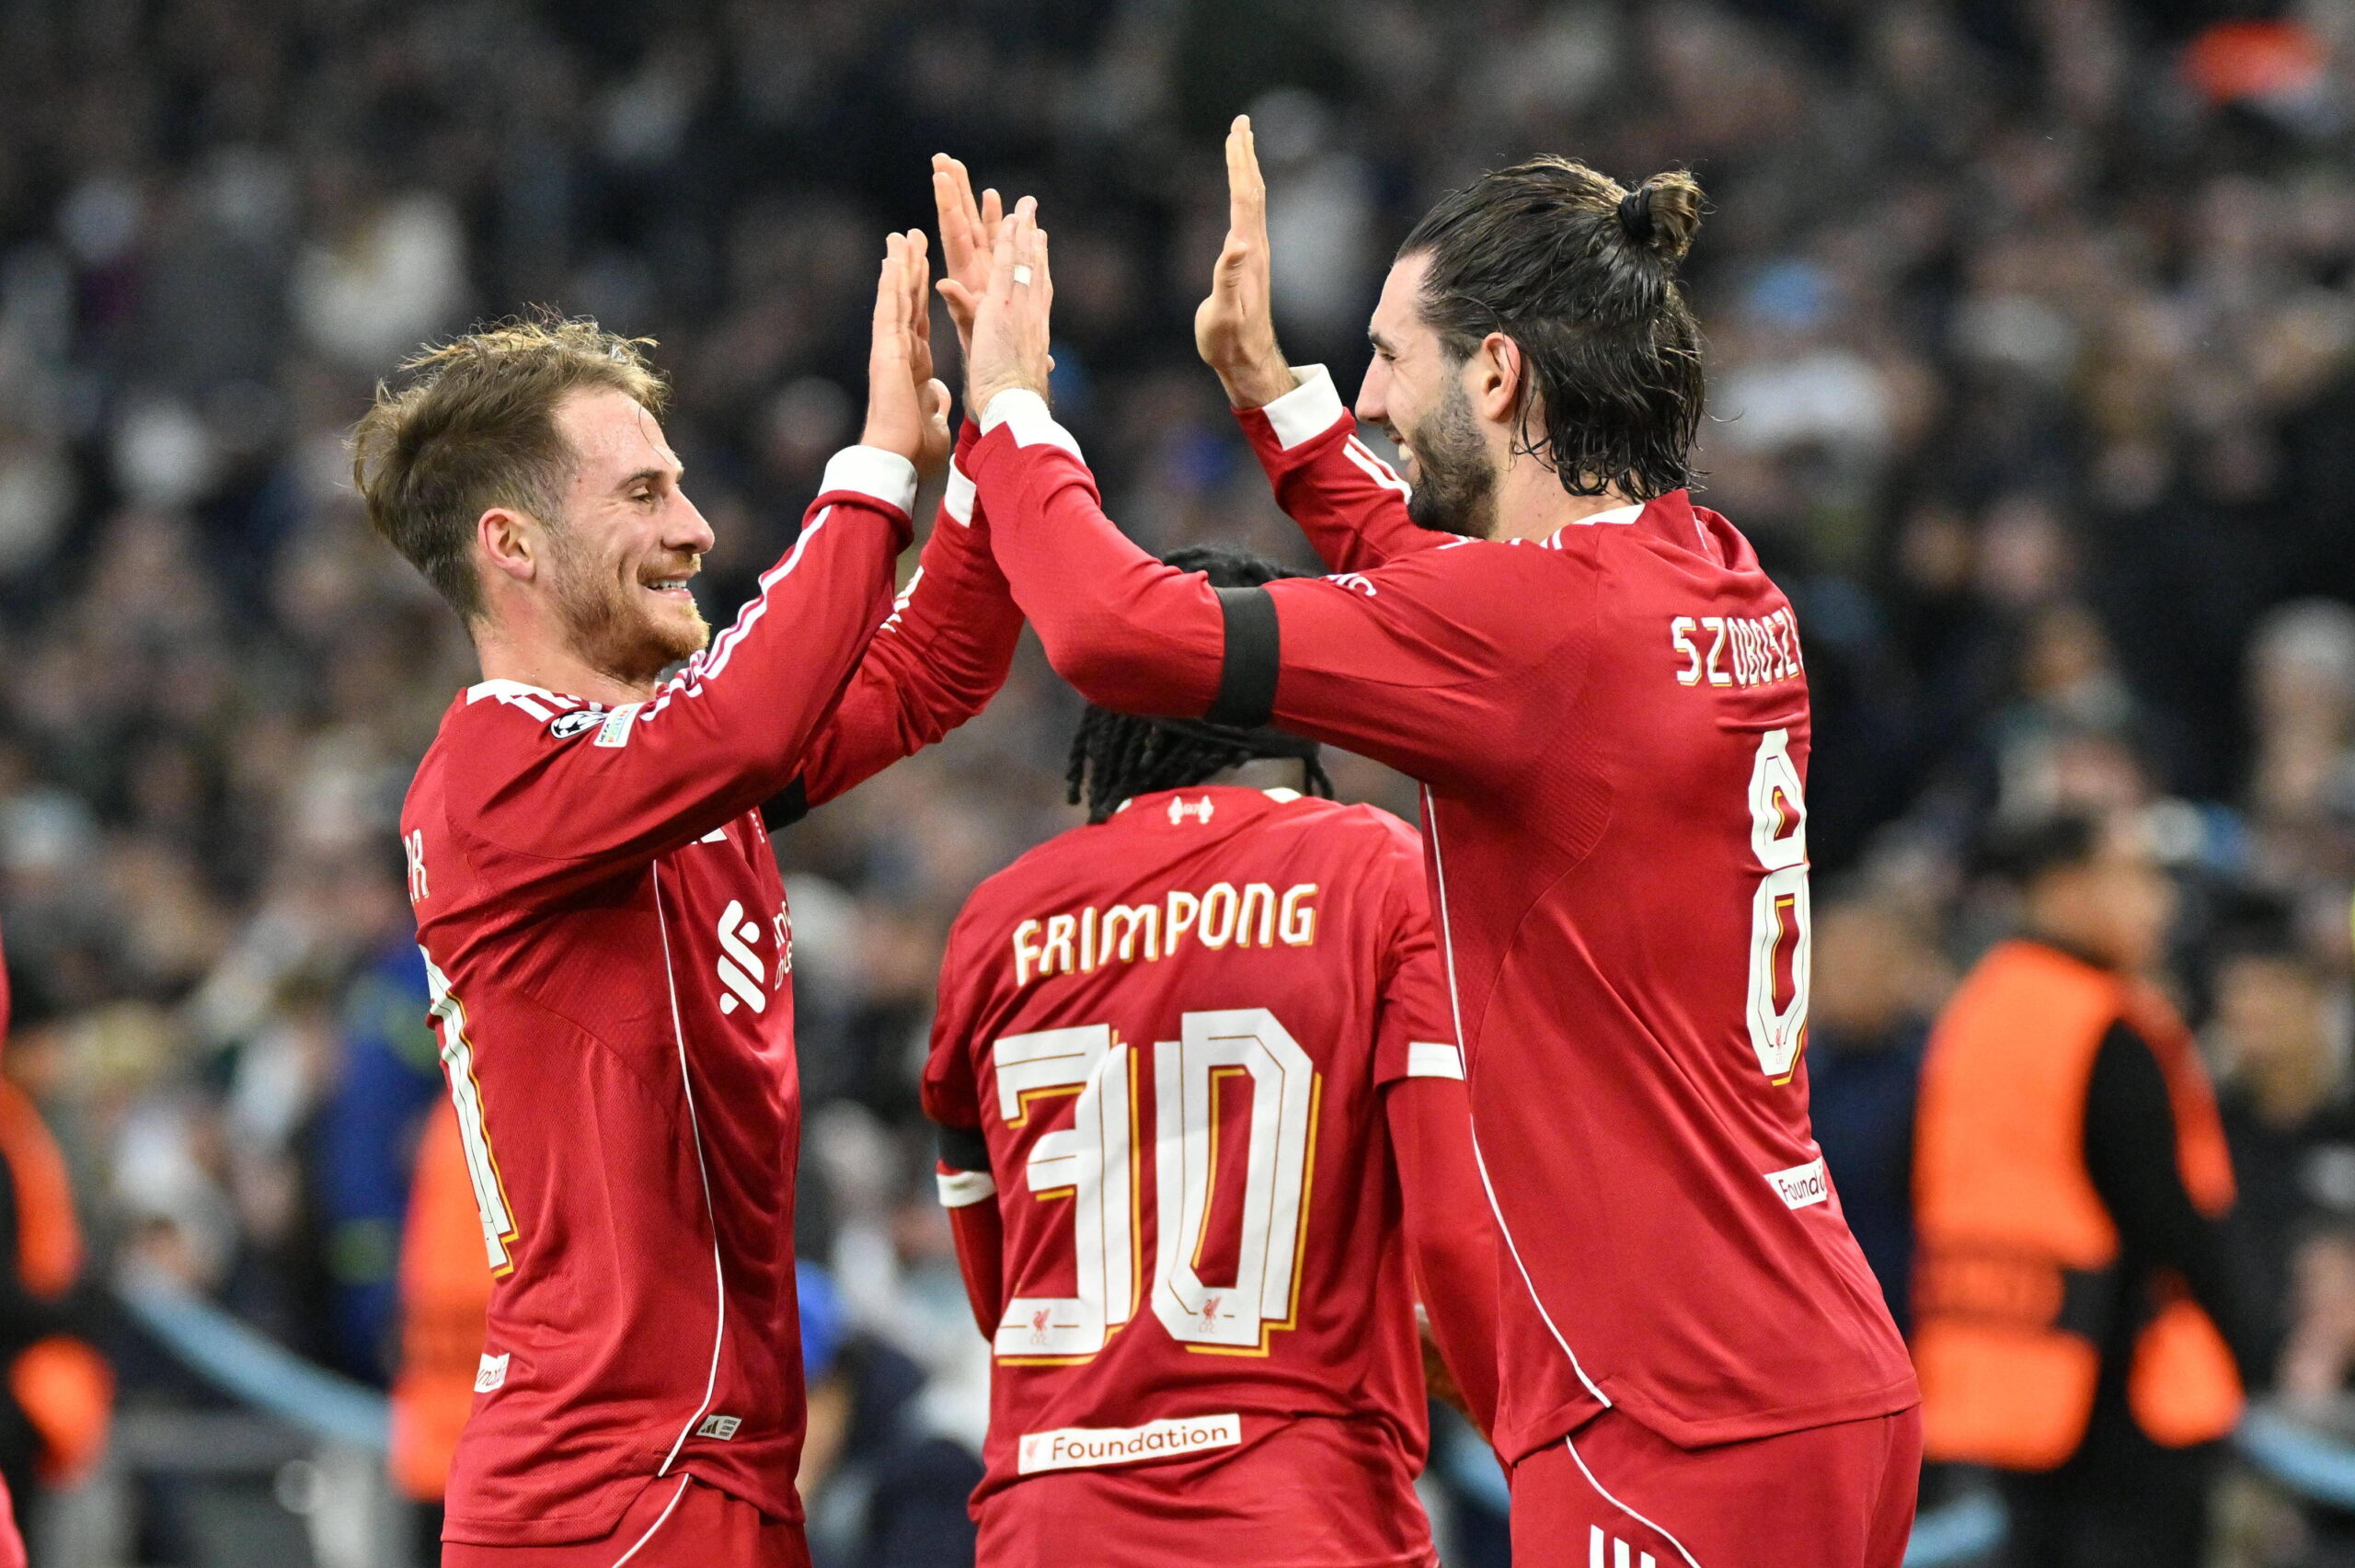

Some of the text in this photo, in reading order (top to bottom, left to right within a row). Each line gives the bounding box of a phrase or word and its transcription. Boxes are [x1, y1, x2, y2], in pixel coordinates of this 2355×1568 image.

[1013, 882, 1317, 986] FRIMPONG
[1746, 727, 1811, 1086] 8
[994, 1008, 1322, 1366] 30
[1051, 1425, 1228, 1460] Foundation
